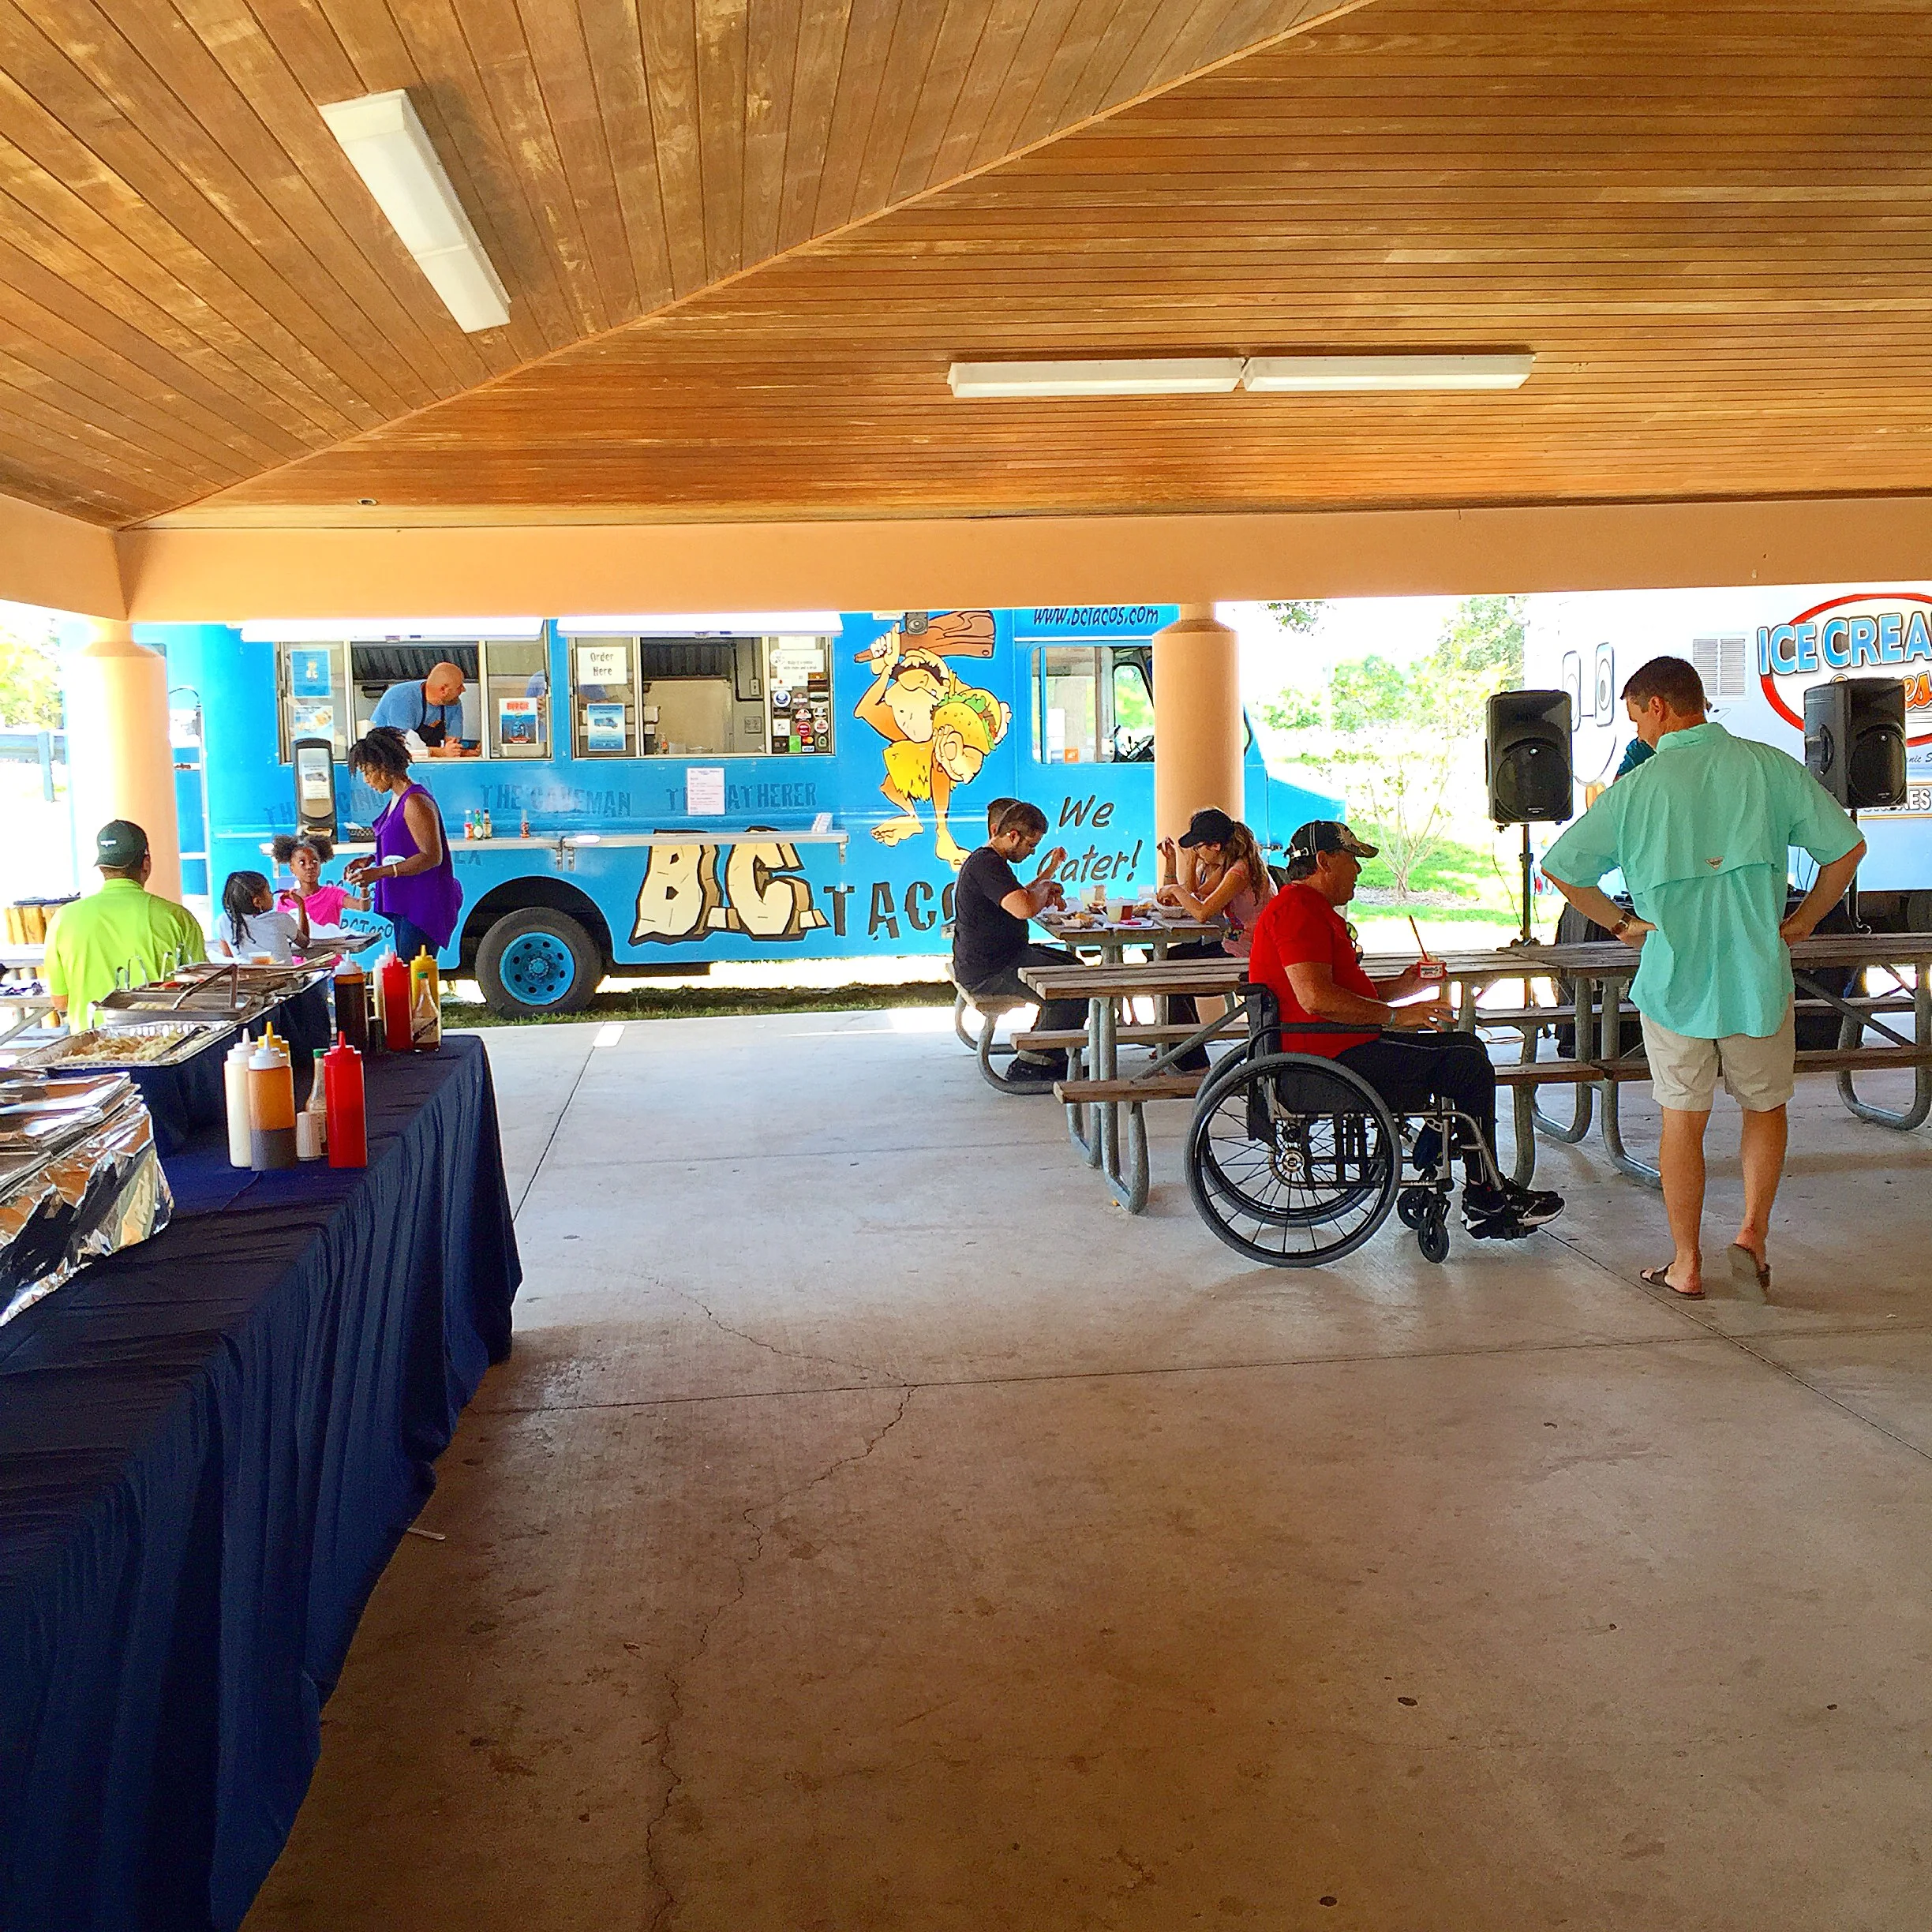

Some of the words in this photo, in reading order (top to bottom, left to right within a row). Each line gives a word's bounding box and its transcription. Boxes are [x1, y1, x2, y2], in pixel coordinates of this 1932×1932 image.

[1757, 622, 1818, 676] ICE
[1822, 610, 1932, 671] CREA
[590, 652, 614, 662] Order
[593, 666, 613, 676] Here
[481, 784, 522, 811] THE
[1058, 794, 1114, 828] We
